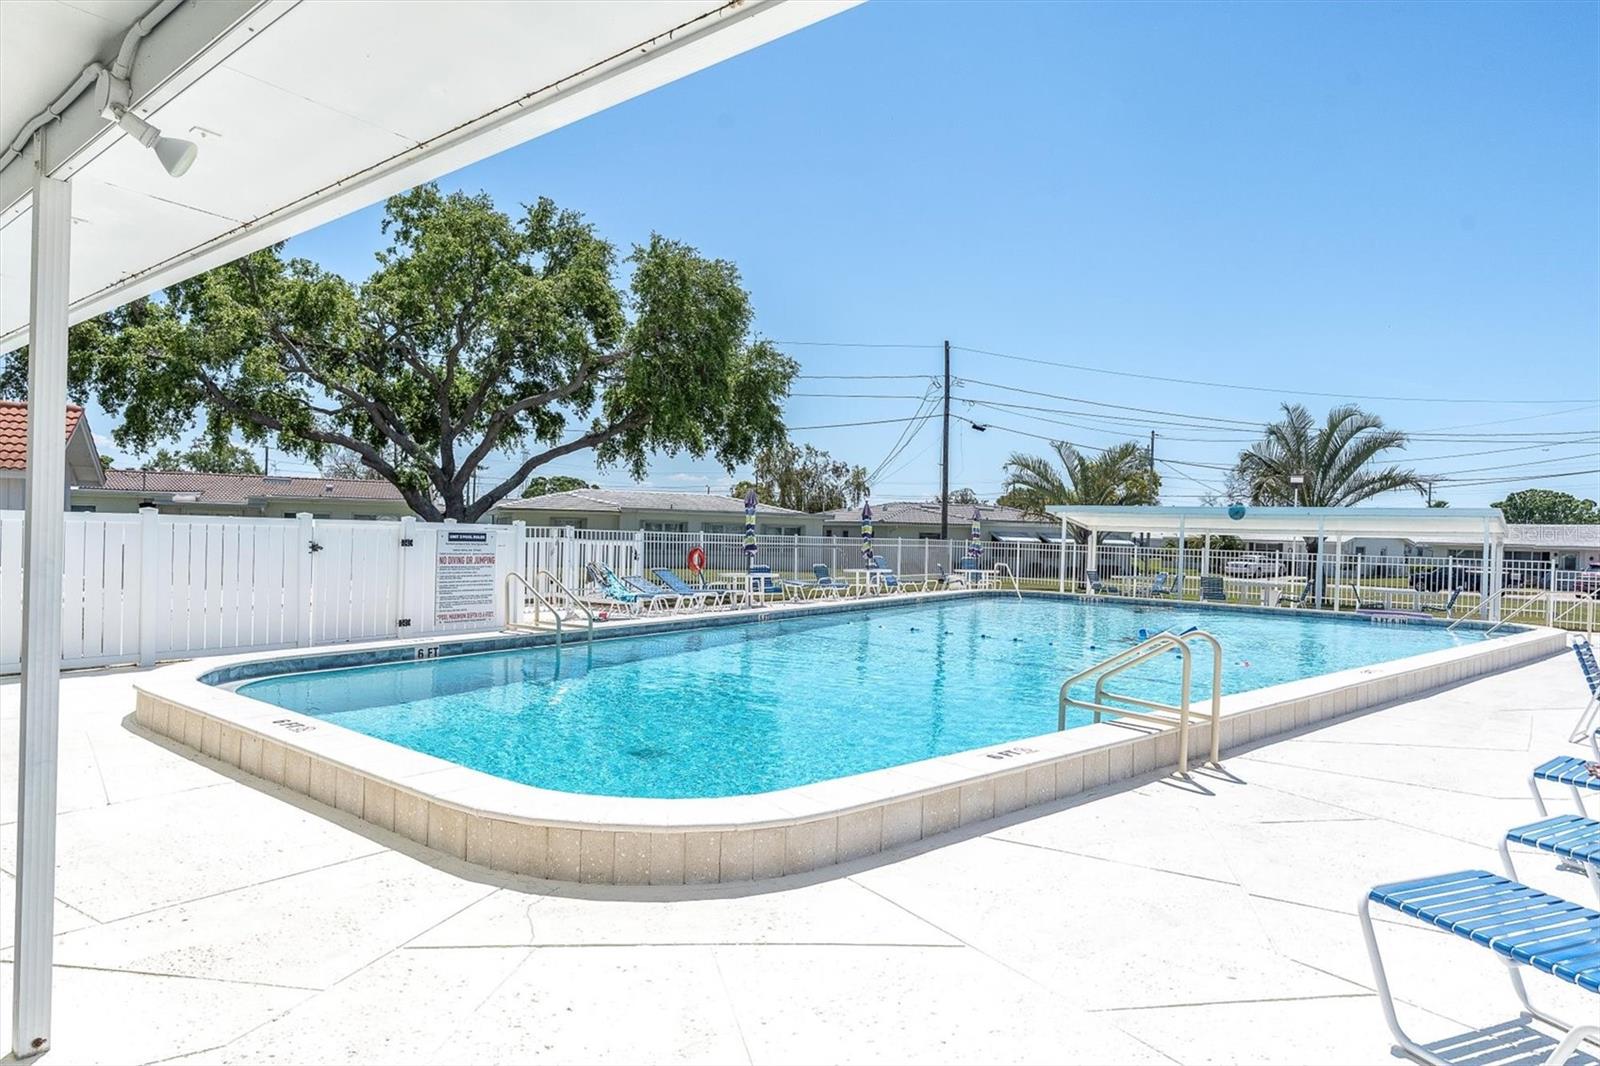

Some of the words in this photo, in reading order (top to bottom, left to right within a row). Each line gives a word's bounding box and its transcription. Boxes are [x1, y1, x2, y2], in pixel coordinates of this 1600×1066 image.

[440, 556, 447, 564] NO
[448, 556, 465, 564] DIVING
[466, 556, 473, 564] OR
[474, 556, 495, 564] JUMPING
[417, 648, 424, 659] 6
[427, 646, 439, 658] FT
